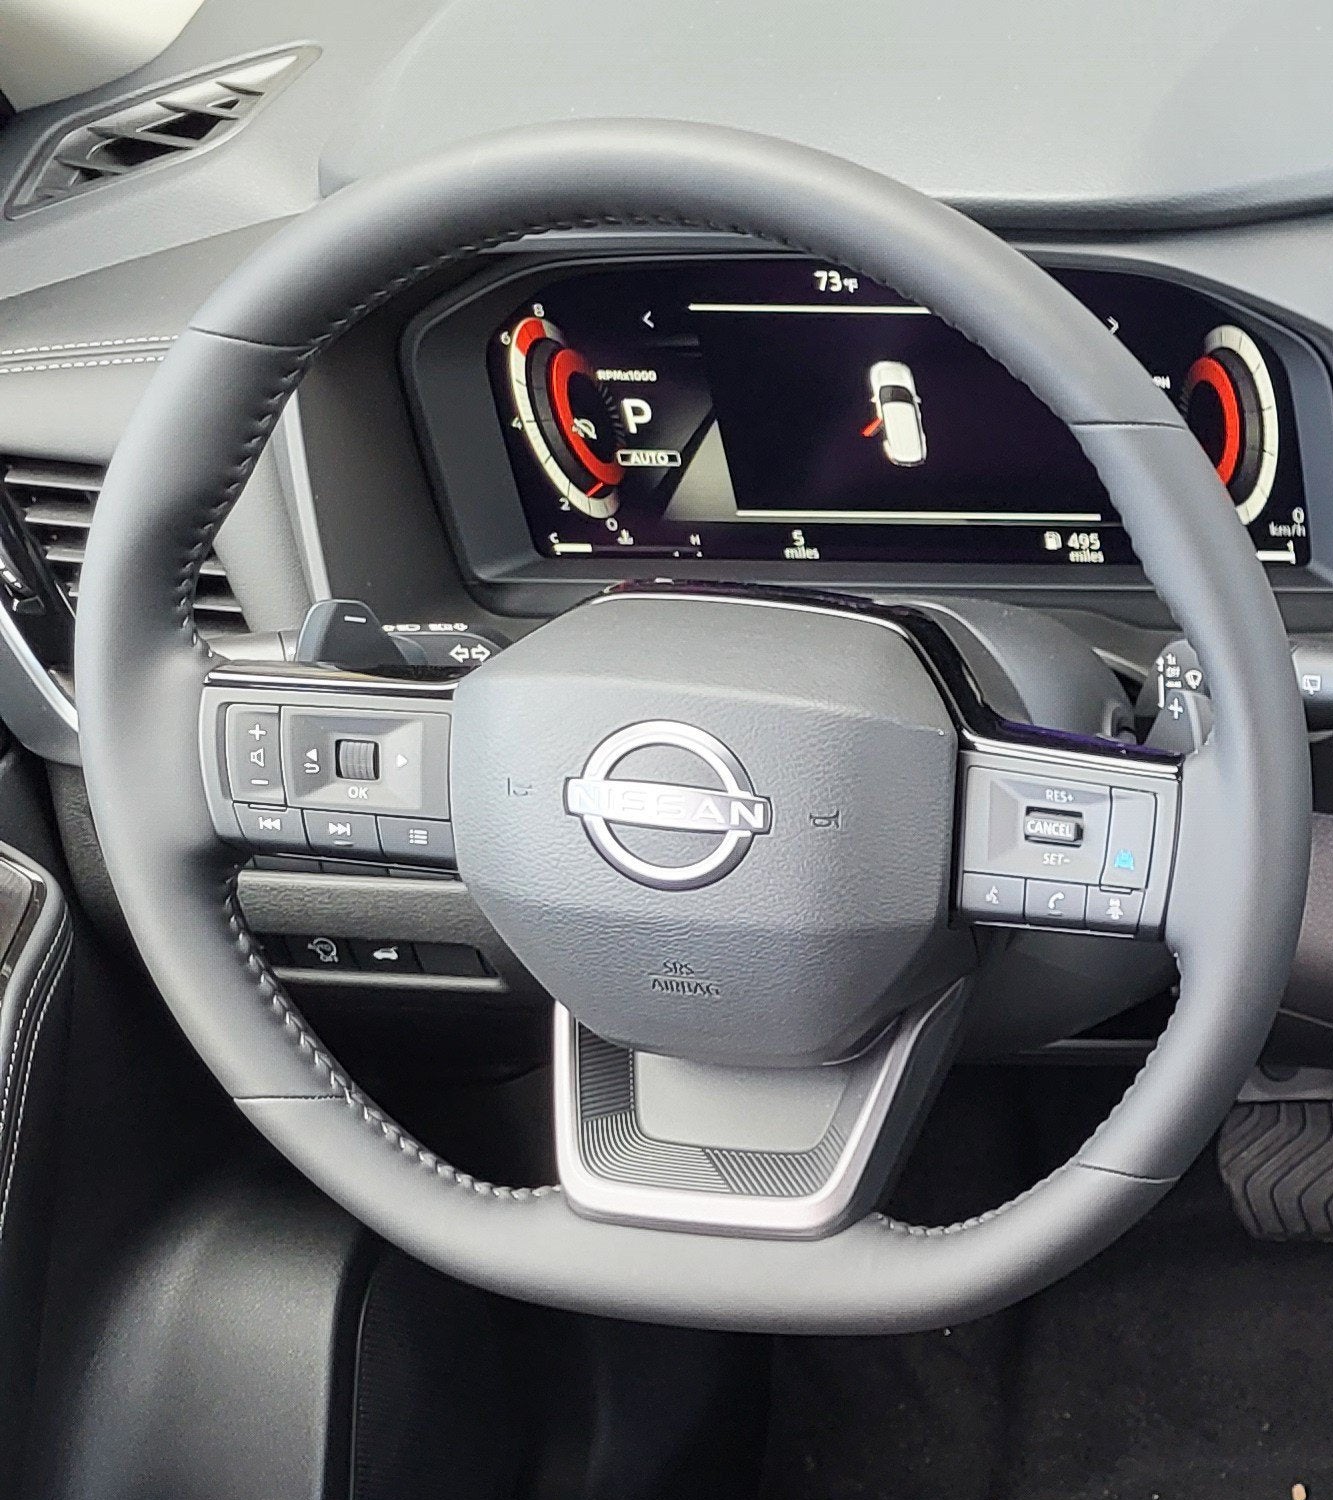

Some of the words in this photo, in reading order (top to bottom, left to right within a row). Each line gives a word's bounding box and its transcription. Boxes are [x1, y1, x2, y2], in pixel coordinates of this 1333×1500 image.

[533, 303, 545, 317] 8
[500, 331, 511, 345] 6
[622, 398, 653, 434] P
[629, 454, 670, 465] AUTO
[559, 497, 571, 511] 2
[1269, 521, 1306, 537] km/h
[1067, 533, 1100, 550] 495
[784, 547, 820, 560] miles
[1069, 550, 1104, 563] miles
[348, 786, 369, 800] OK
[1045, 789, 1074, 804] RES+
[570, 782, 765, 831] NISSAN
[1026, 820, 1073, 838] CANCEL
[1042, 854, 1070, 866] SET-
[662, 959, 695, 976] SRS
[650, 978, 720, 996] AIRBAG
